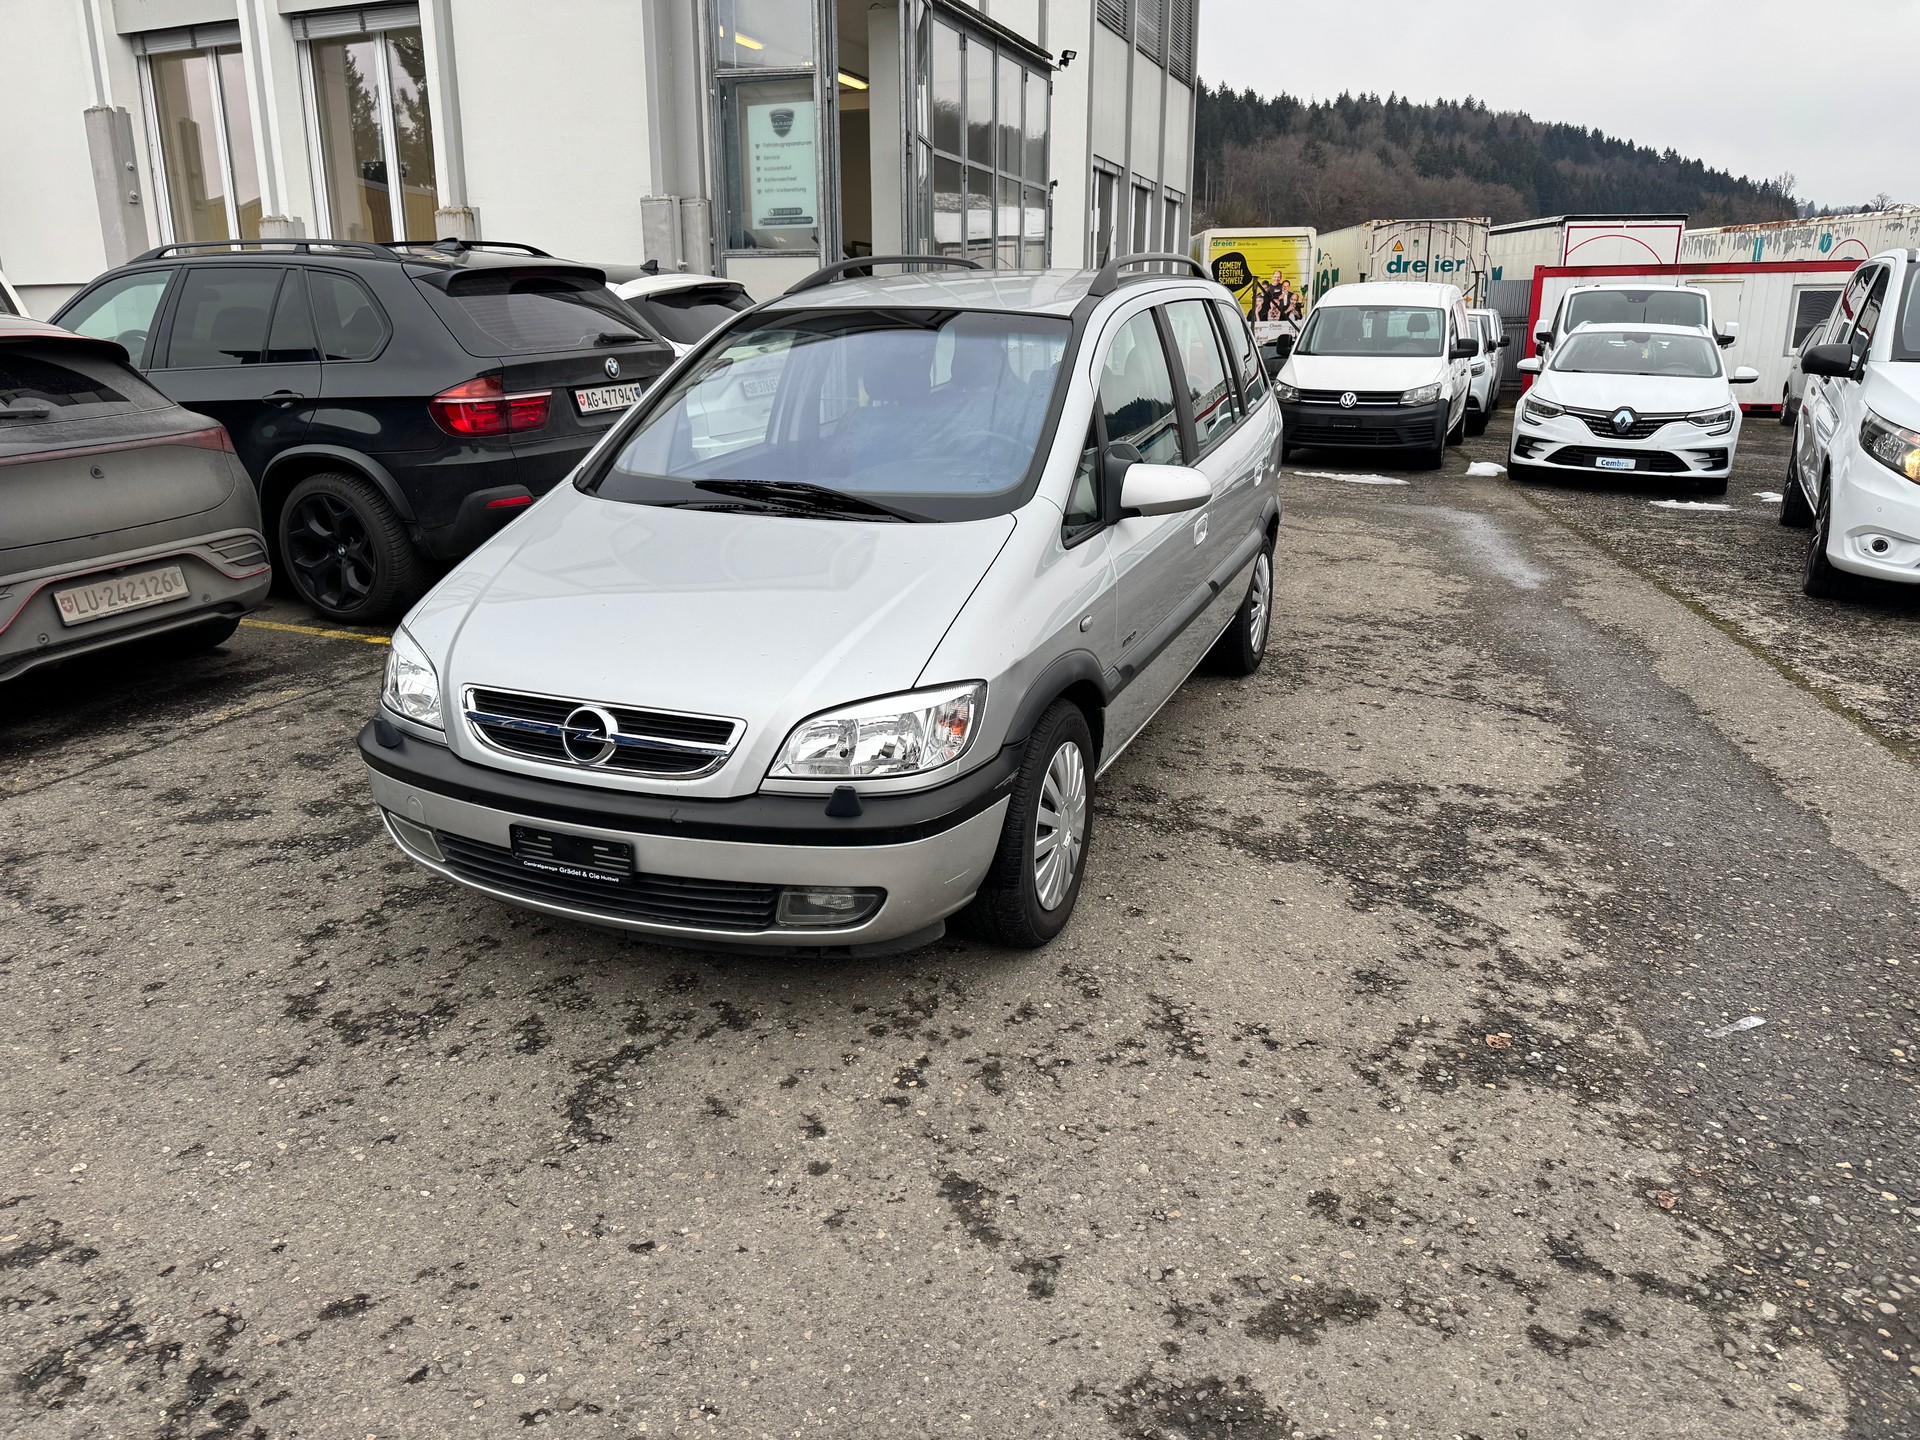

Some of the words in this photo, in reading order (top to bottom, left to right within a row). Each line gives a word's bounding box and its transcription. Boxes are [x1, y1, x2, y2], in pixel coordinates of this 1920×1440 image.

[1212, 239, 1236, 247] dreier
[1218, 261, 1242, 269] COMEDY
[1386, 254, 1465, 273] dreier
[1218, 269, 1244, 277] FESTIVAL
[1218, 276, 1243, 285] SCHWEIZ
[1600, 459, 1629, 467] Cembra
[523, 860, 558, 872] Centralgarage
[559, 866, 581, 876] Grädel
[588, 872, 600, 880] Cie
